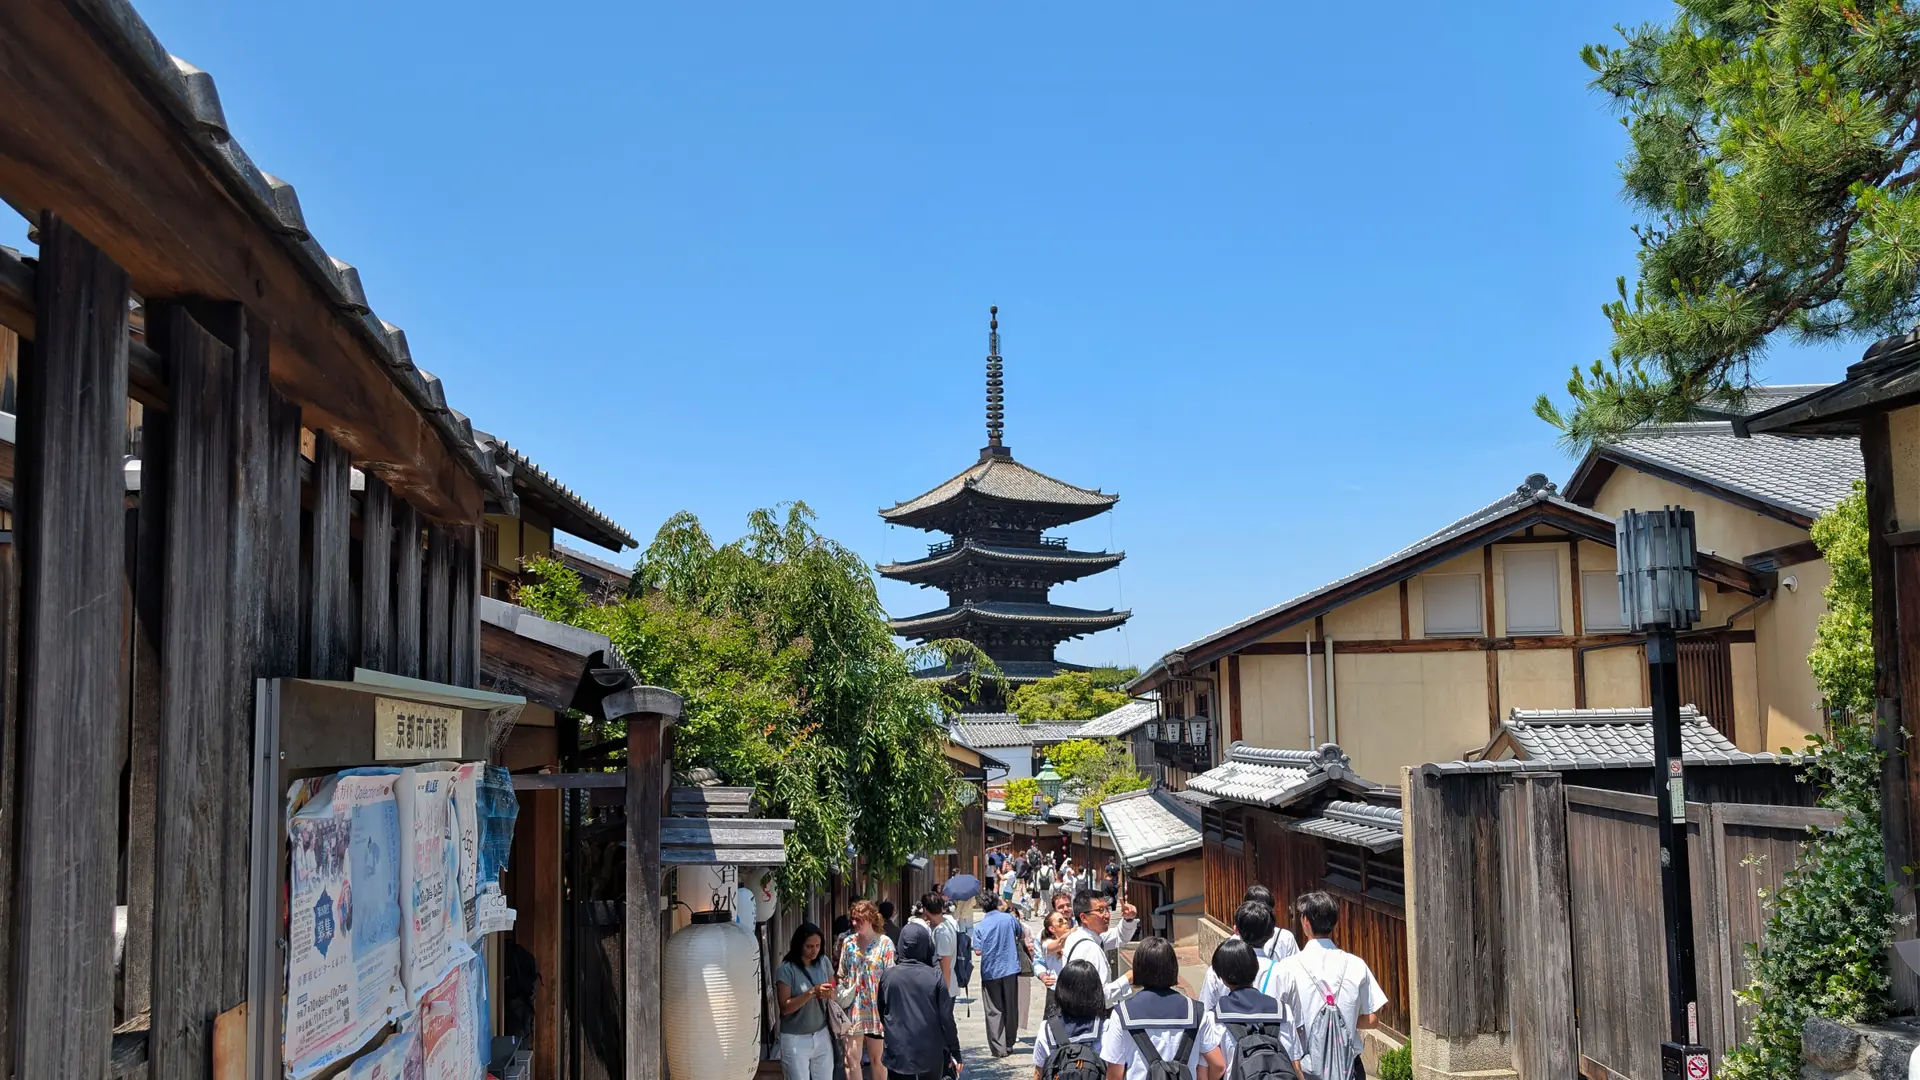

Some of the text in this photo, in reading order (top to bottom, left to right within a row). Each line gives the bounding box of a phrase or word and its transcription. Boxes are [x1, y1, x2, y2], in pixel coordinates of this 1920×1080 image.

[396, 712, 448, 750] 京都市広報板
[317, 918, 333, 943] 募集
